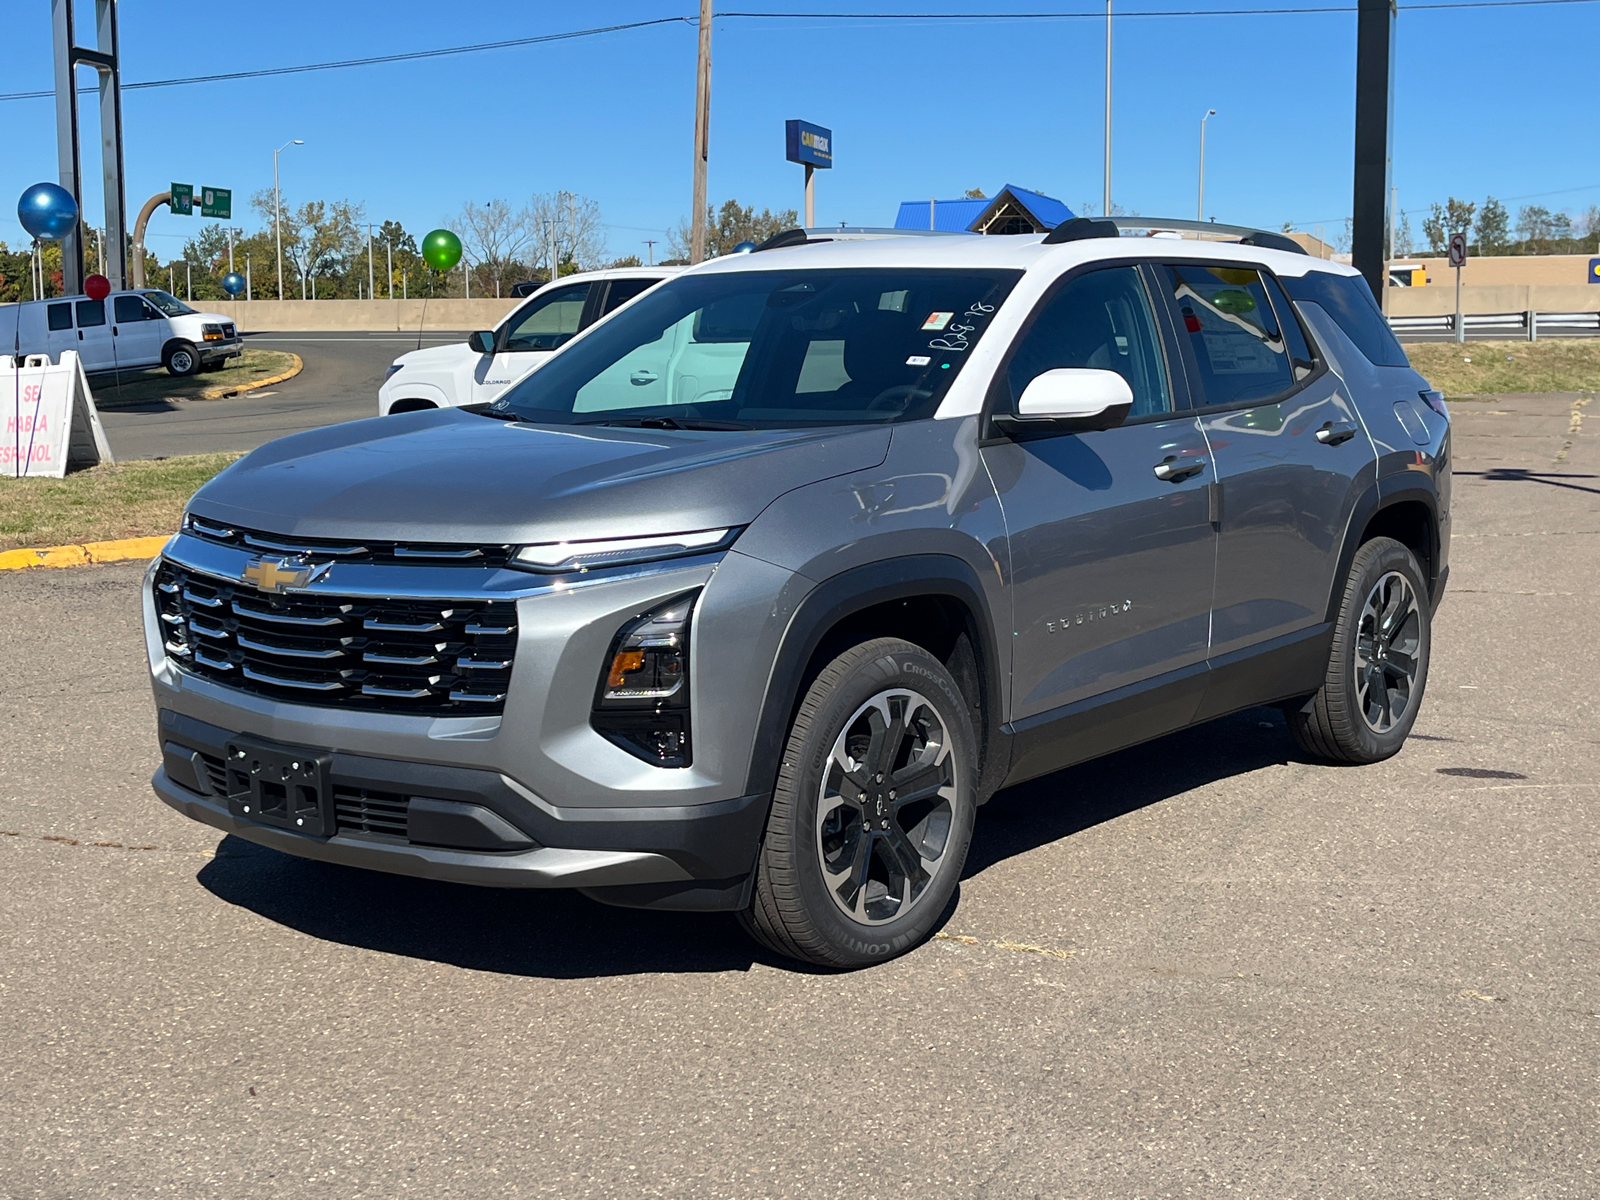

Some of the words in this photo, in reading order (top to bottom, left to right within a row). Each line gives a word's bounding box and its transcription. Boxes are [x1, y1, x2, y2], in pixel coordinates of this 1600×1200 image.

[24, 385, 40, 402] SE
[7, 415, 48, 433] HABLA
[1046, 599, 1131, 633] EQUINOX
